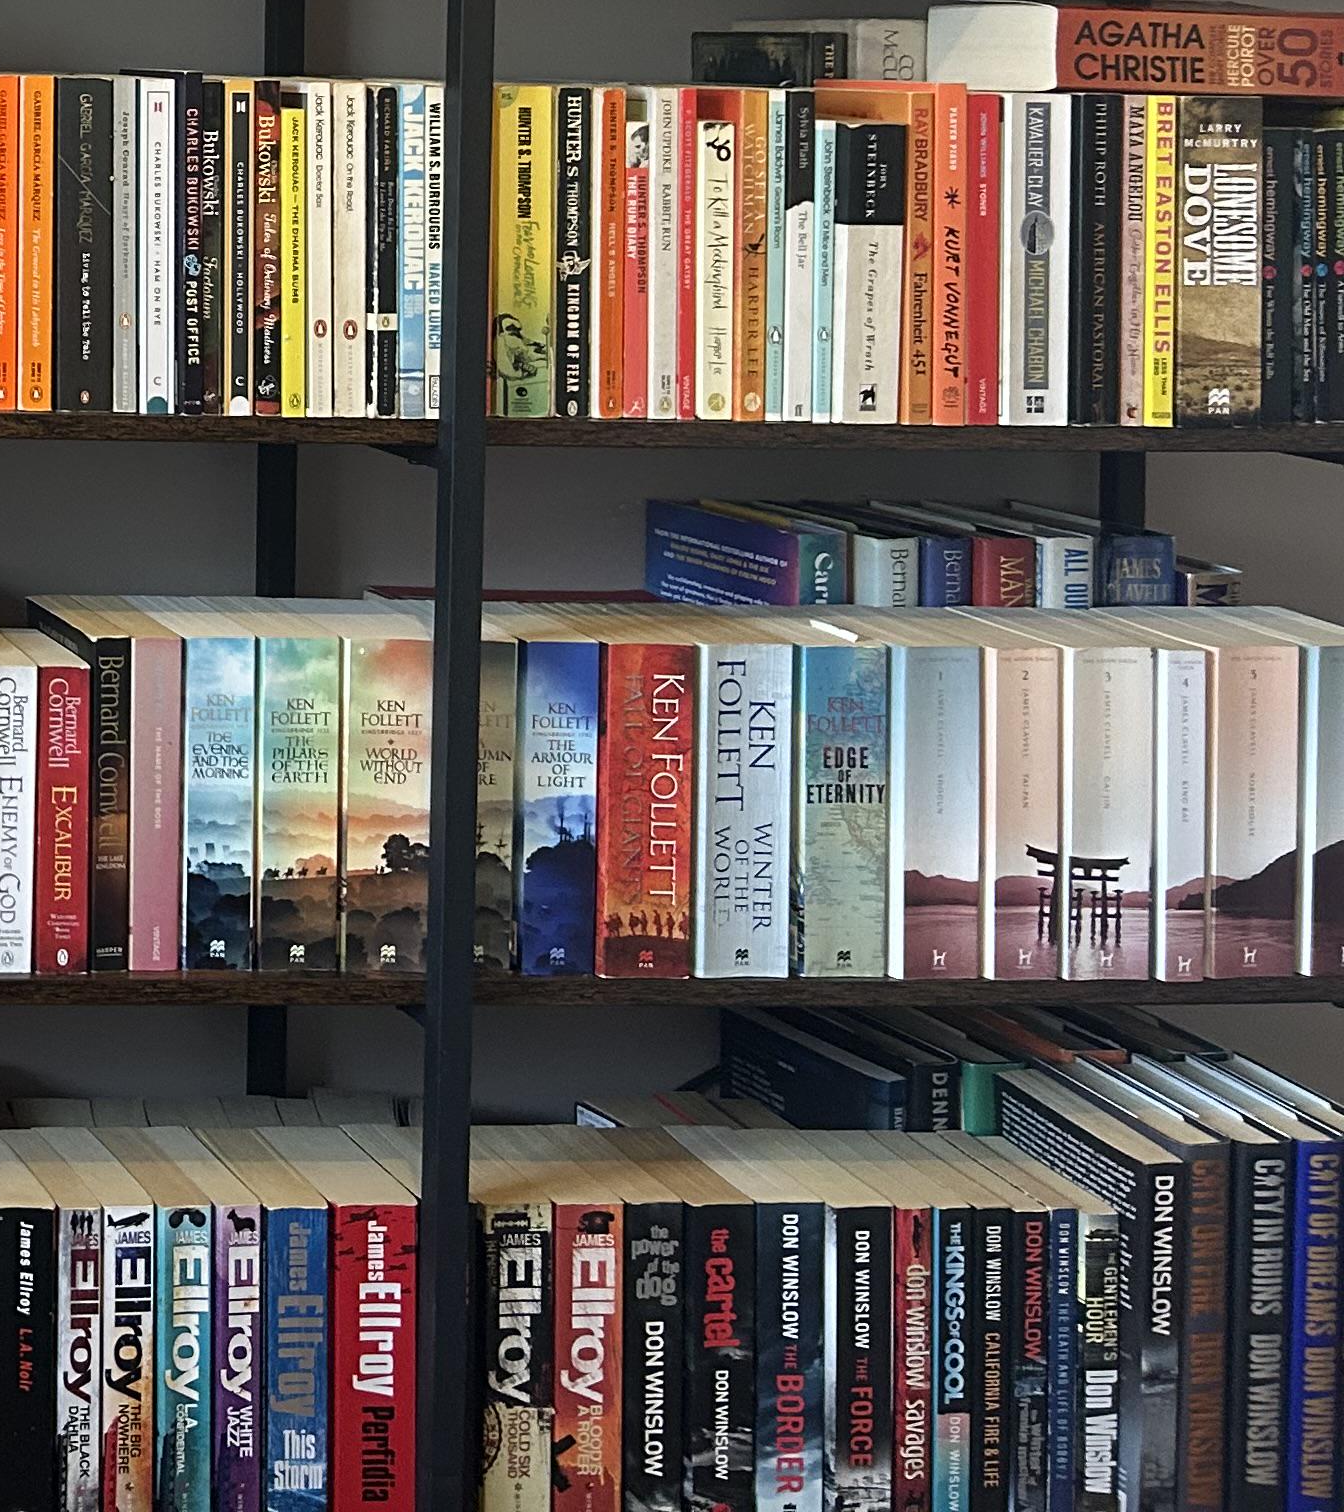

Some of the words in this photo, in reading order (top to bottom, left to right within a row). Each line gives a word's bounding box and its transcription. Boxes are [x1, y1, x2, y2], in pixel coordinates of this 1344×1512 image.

[1074, 21, 1203, 49] AGATHA
[1074, 53, 1204, 83] CHRISTIE
[1184, 138, 1258, 149] McMURTRY
[1199, 124, 1241, 133] LARRY
[1183, 164, 1211, 286] DOVE
[1212, 163, 1257, 286] LONESOME
[944, 226, 961, 283] KURT
[912, 273, 929, 345] Fahrenheit
[943, 287, 961, 377] VONNEGUT
[361, 712, 423, 728] FOLLETT
[377, 700, 405, 712] KEN
[650, 674, 685, 741] KEN
[360, 759, 423, 774] WITHOUT
[365, 748, 417, 761] WORLD
[375, 772, 407, 785] END
[823, 747, 868, 768] EDGE
[838, 770, 852, 781] OF
[807, 785, 885, 804] ETERNITY
[51, 785, 77, 902] EXCALIBUR
[649, 754, 682, 905] FOLLETT
[367, 1220, 384, 1281] James
[353, 1282, 401, 1397] Ellroy
[644, 1321, 664, 1367] DON
[644, 1371, 664, 1477] WINSLOW
[776, 1375, 804, 1493] BORDER
[362, 1406, 394, 1502] Perfidia
